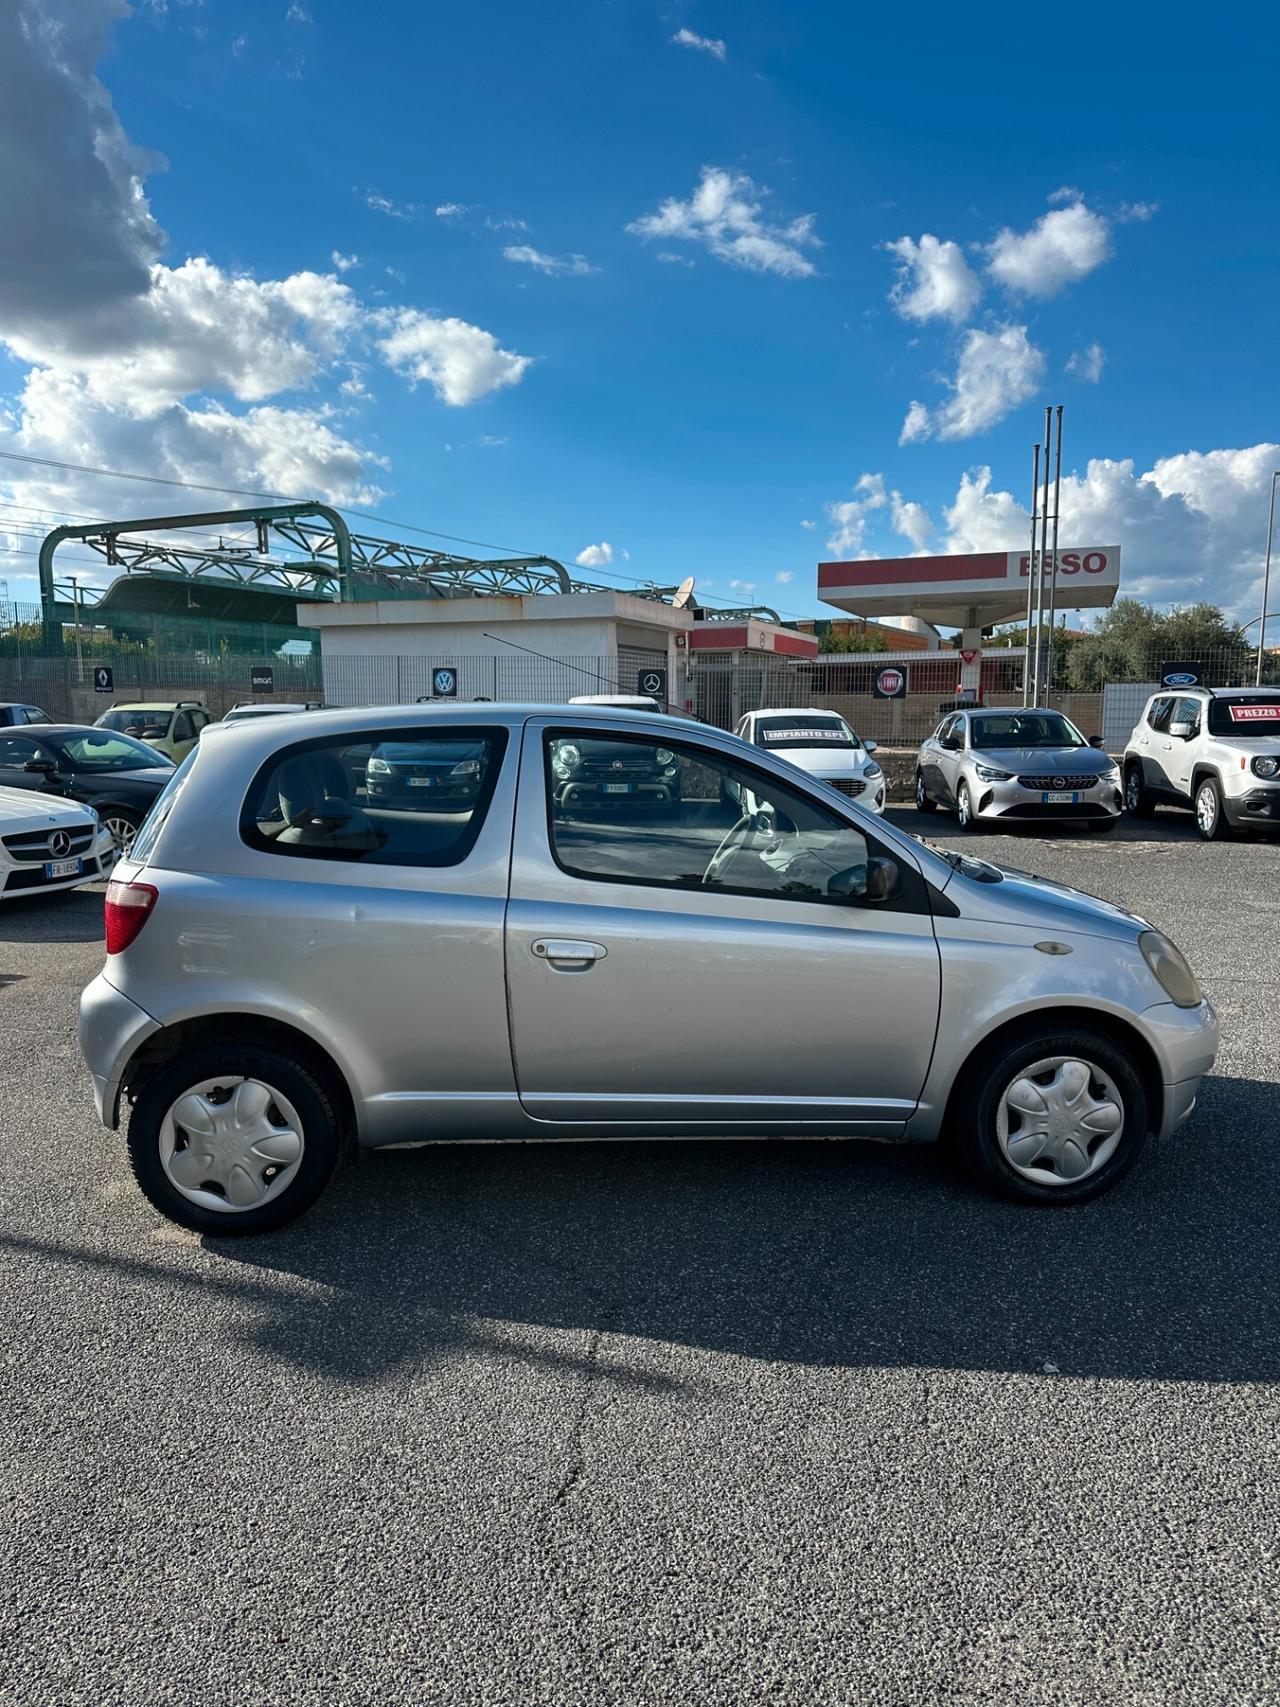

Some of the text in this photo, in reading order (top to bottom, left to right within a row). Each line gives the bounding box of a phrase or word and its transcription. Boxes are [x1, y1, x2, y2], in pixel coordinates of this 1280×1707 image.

[1019, 552, 1108, 577] ESSO
[883, 677, 898, 688] FIAT
[1236, 708, 1277, 718] PREZZO
[769, 731, 823, 739] IMPIANTO
